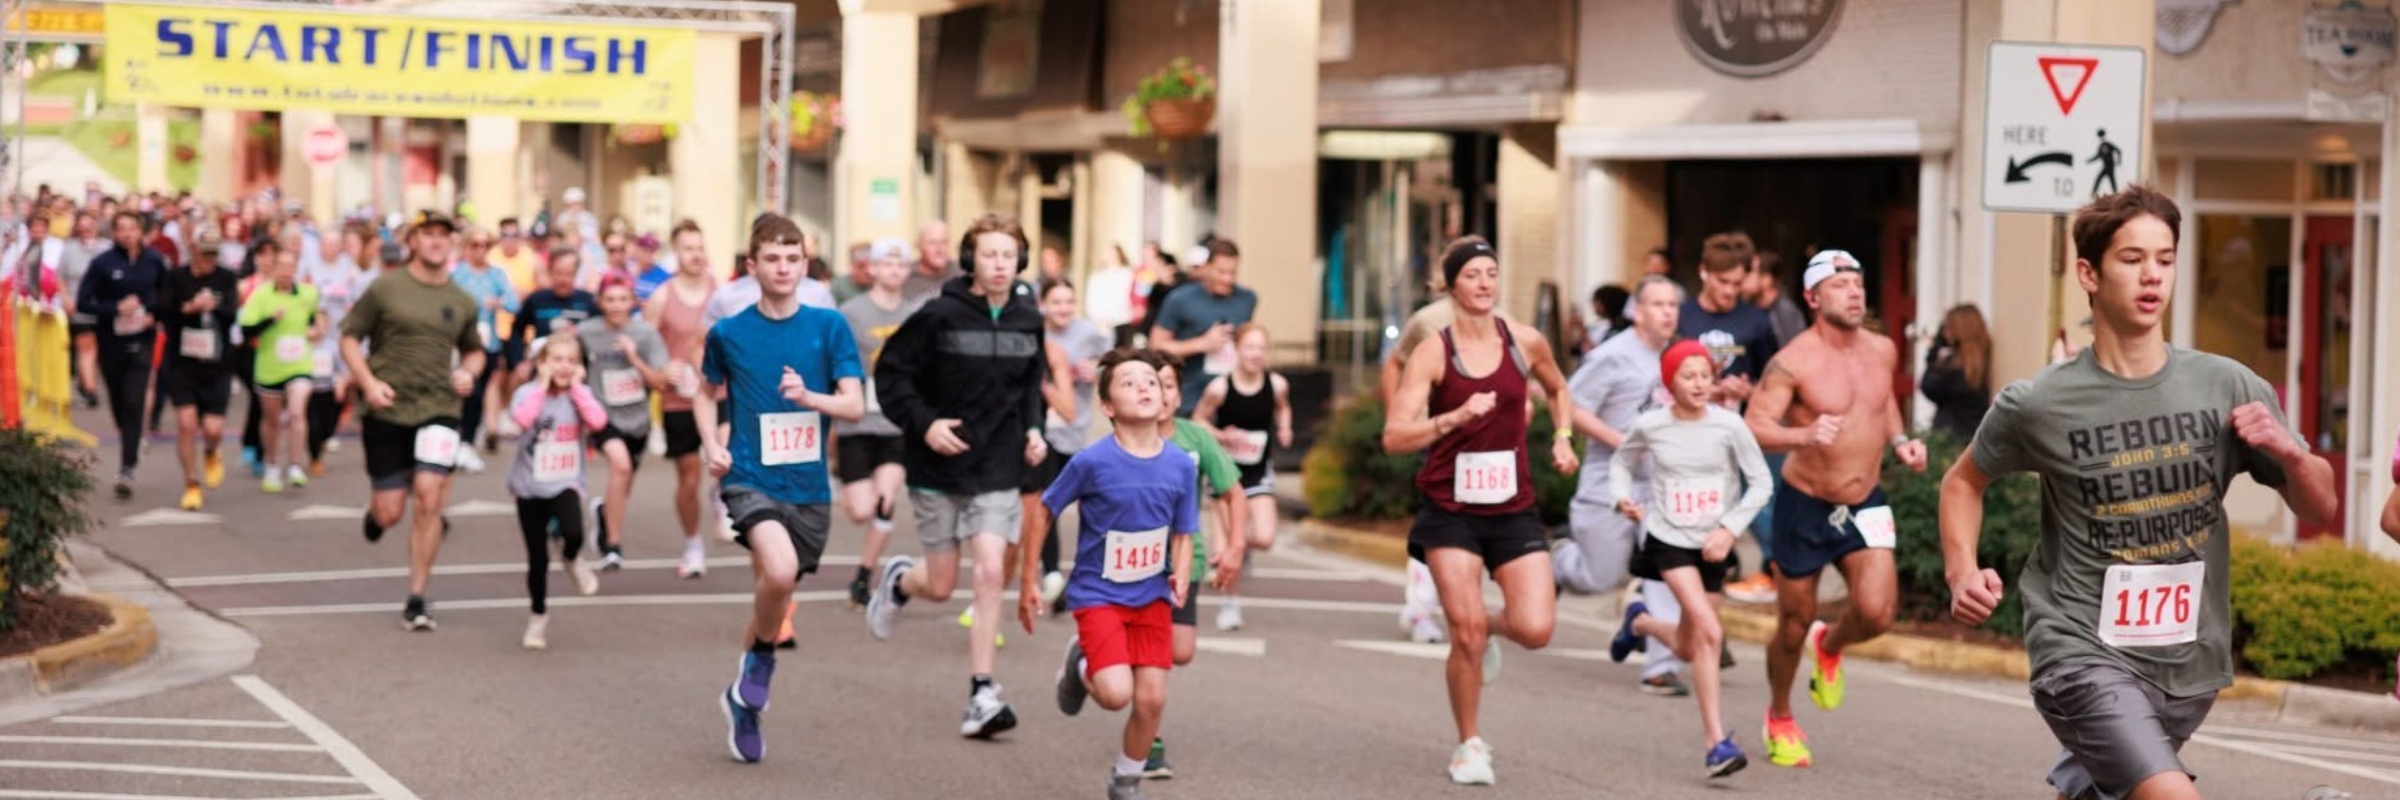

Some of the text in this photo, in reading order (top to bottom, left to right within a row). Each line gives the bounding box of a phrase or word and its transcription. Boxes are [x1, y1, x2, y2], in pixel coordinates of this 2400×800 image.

[156, 18, 647, 75] START/FINISH
[2003, 126, 2047, 144] HERE
[2053, 178, 2074, 196] TO
[770, 426, 815, 450] 1178
[2068, 409, 2220, 460] REBORN
[2110, 449, 2154, 467] JOHN
[1465, 466, 1509, 489] 1168
[1114, 543, 1161, 569] 1416
[2114, 584, 2190, 626] 1176
